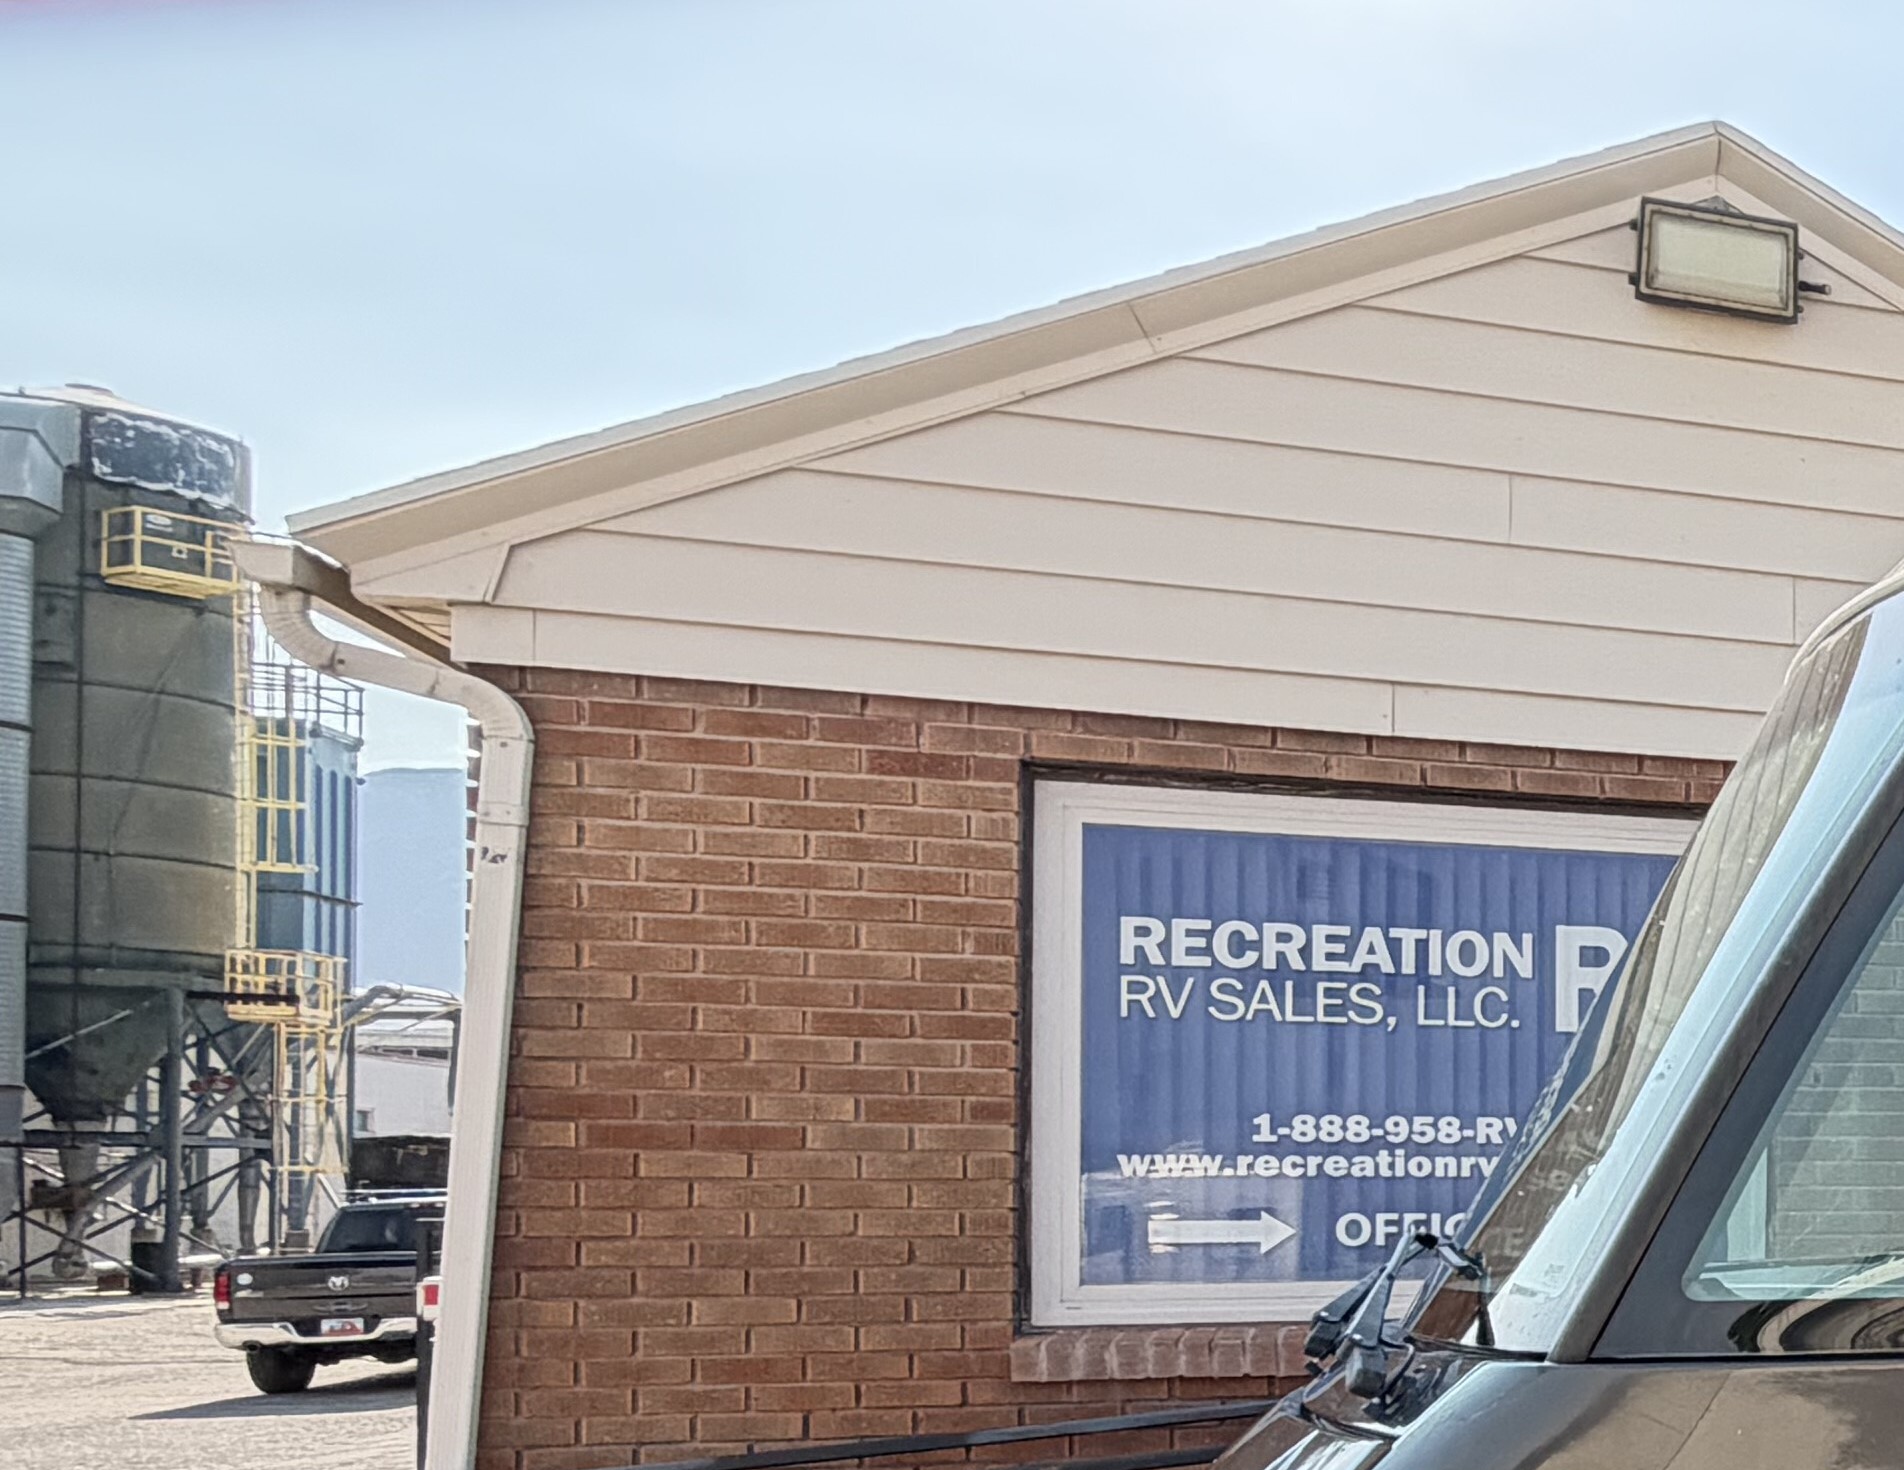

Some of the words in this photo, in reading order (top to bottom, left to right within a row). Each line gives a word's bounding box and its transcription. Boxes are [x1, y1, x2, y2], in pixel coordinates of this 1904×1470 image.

[1118, 916, 1533, 979] RECREATION
[1118, 975, 1194, 1020] RV
[1208, 977, 1398, 1033] SALES,
[1416, 984, 1521, 1028] LLC.
[1117, 1149, 1499, 1178] www.recreationrv
